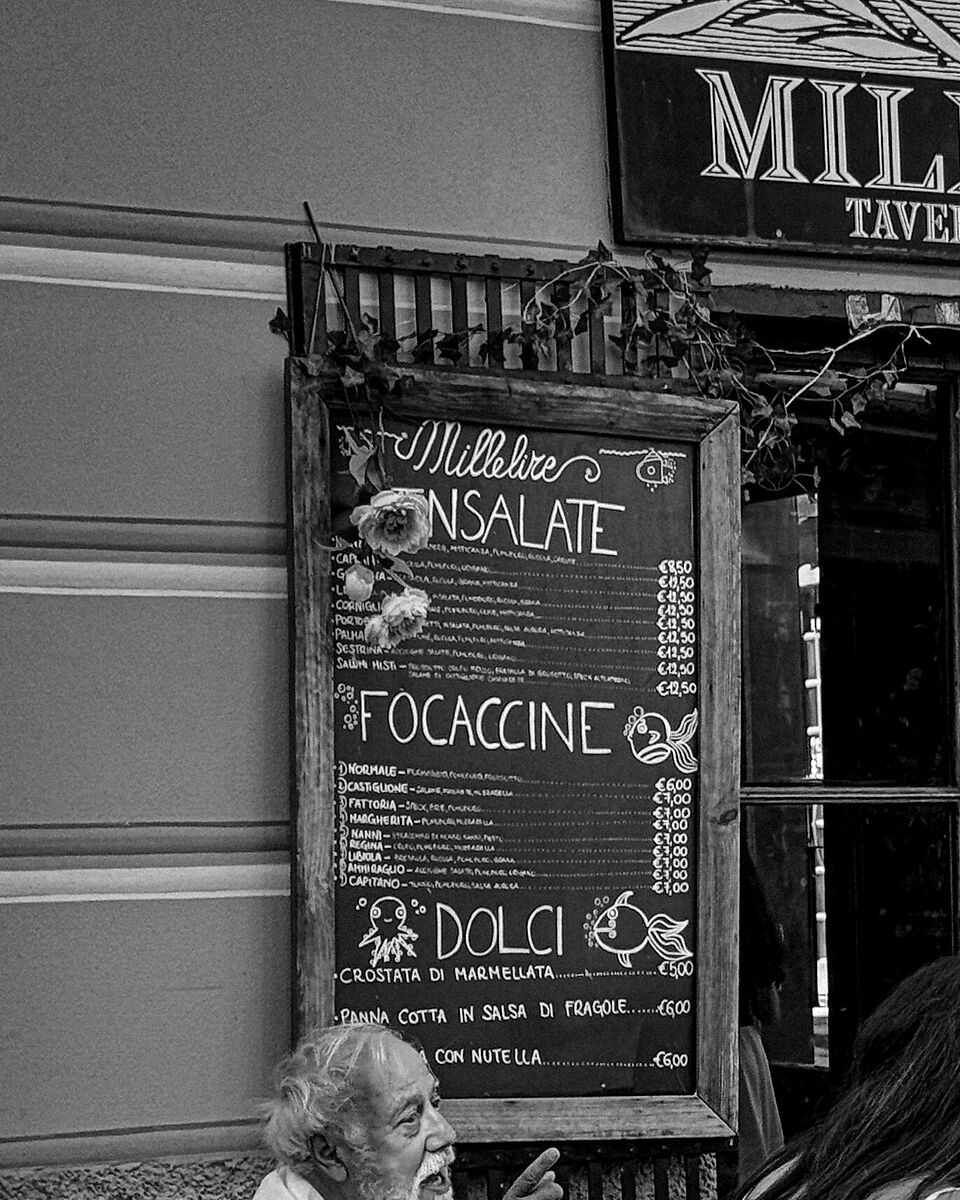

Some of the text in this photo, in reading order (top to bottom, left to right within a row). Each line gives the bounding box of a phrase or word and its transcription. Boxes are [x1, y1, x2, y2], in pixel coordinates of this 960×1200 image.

[395, 418, 601, 484] Millelire
[391, 488, 626, 556] NSALATE
[657, 559, 692, 575] €8,50
[336, 599, 381, 613] CORNIGLI
[656, 680, 697, 698] €12,50
[361, 688, 616, 754] FOCACCINE
[655, 777, 692, 793] €6,00
[652, 791, 692, 807] €7,00
[653, 806, 691, 820] €7,00
[652, 818, 688, 832] €7,00
[653, 833, 688, 846] €7,00
[652, 858, 688, 872] €7,00
[652, 869, 688, 882] €7,00
[652, 881, 689, 896] €7,00
[436, 902, 564, 960] DOLCI
[339, 961, 694, 983] CROSTATA DI MARMELLATA €5,00
[340, 999, 691, 1025] PANNA COTTA IN SALSA DI FRAGOLE €6,00
[435, 1049, 688, 1070] CON NUTELLA €6,00
